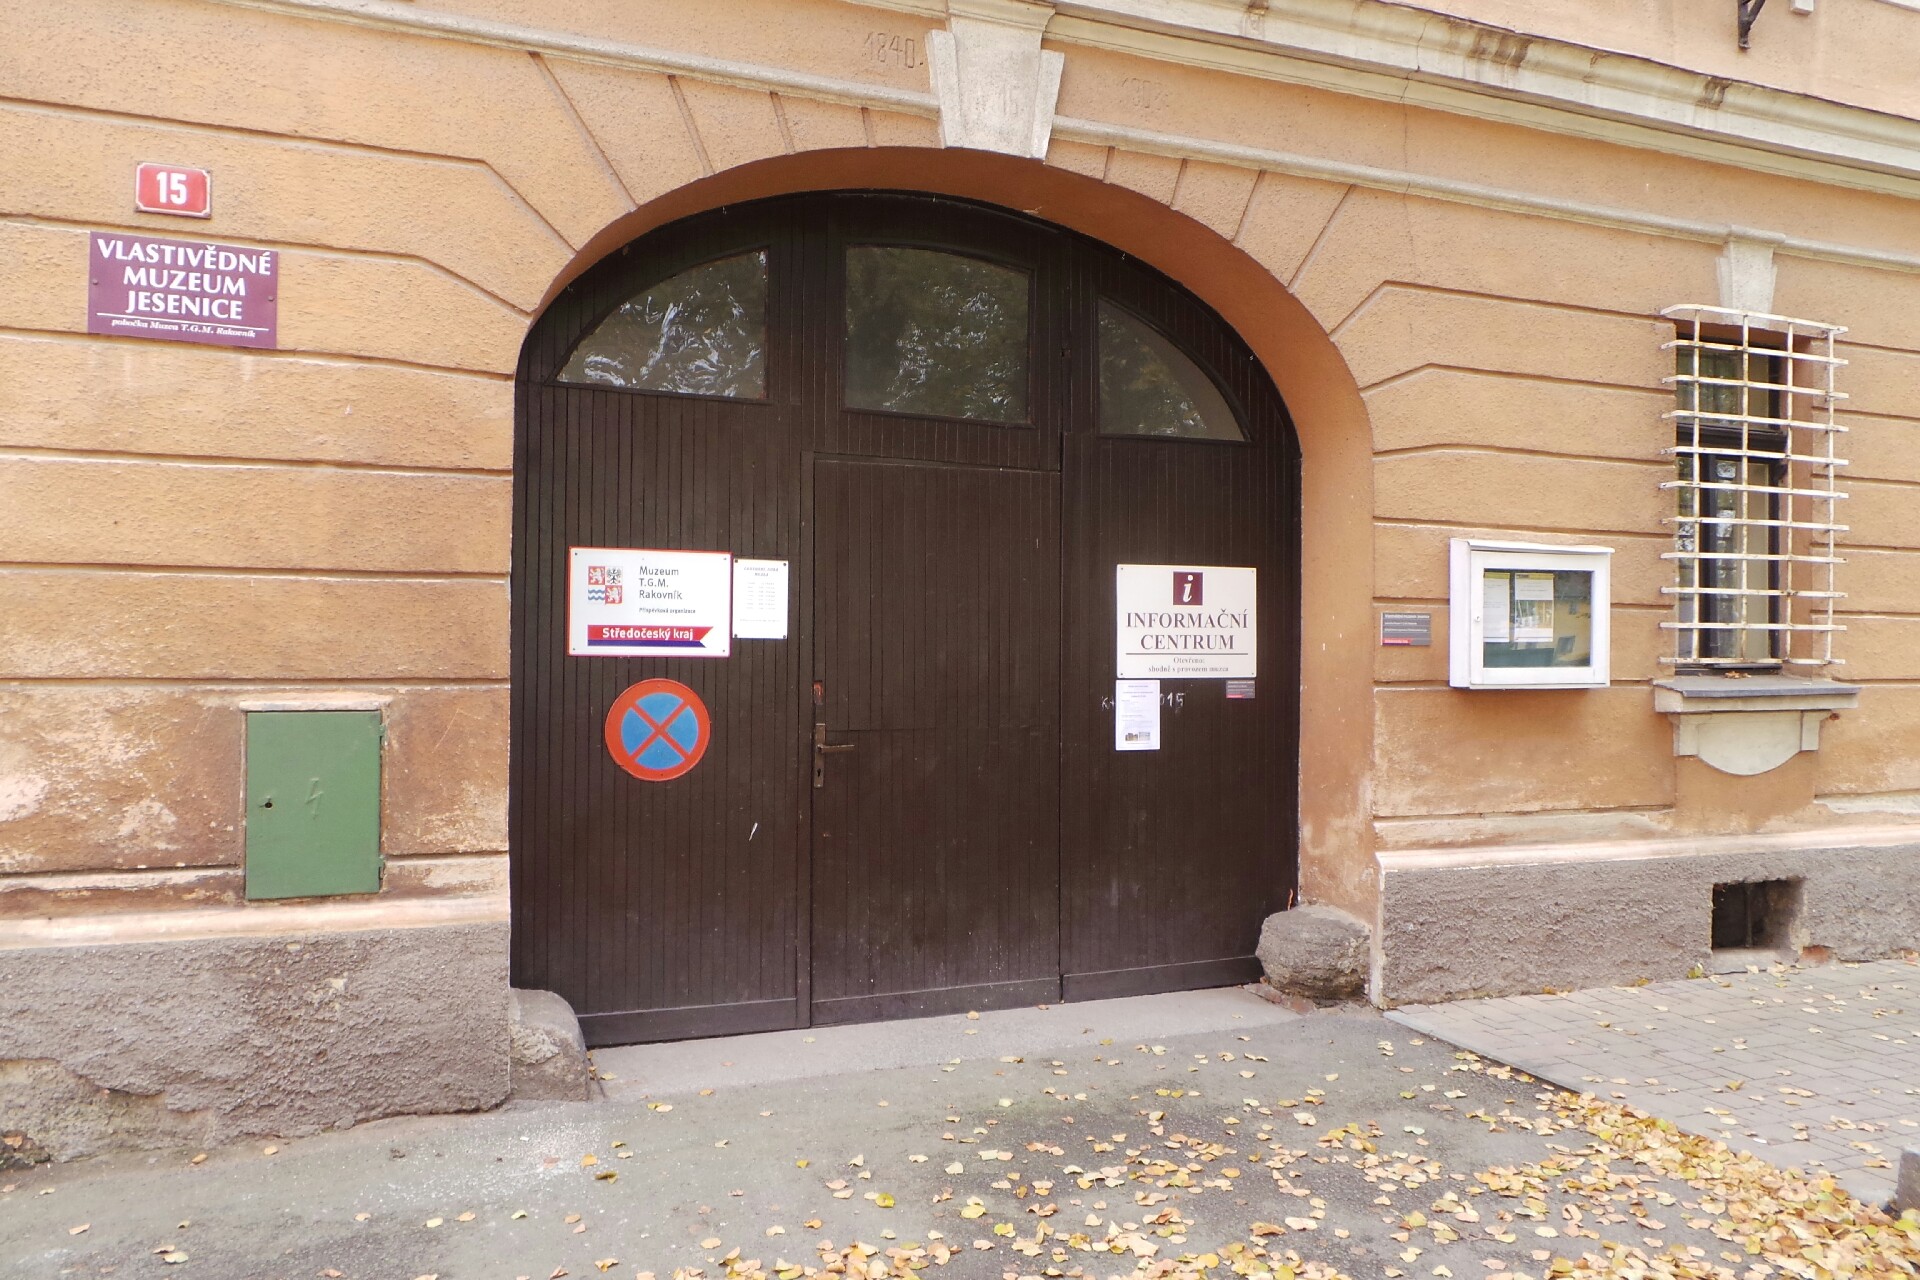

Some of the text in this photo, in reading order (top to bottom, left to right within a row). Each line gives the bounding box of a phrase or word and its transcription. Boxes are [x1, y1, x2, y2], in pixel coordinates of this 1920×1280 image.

[155, 171, 188, 205] 15
[97, 238, 271, 276] VLASTIVĚDNÉ
[123, 266, 246, 296] MUZEUM
[125, 290, 243, 320] JESENICE
[111, 318, 148, 329] pobočka
[181, 324, 214, 334] T.G.M.
[216, 327, 256, 338] Rakovník
[639, 565, 679, 576] Muzeum
[639, 577, 669, 588] T.G.M.
[639, 589, 683, 600] Rakovník
[1126, 608, 1248, 629] INFORMAČNÍ
[602, 627, 694, 641] Středočeský kraj
[1140, 634, 1234, 650] CENTRUM
